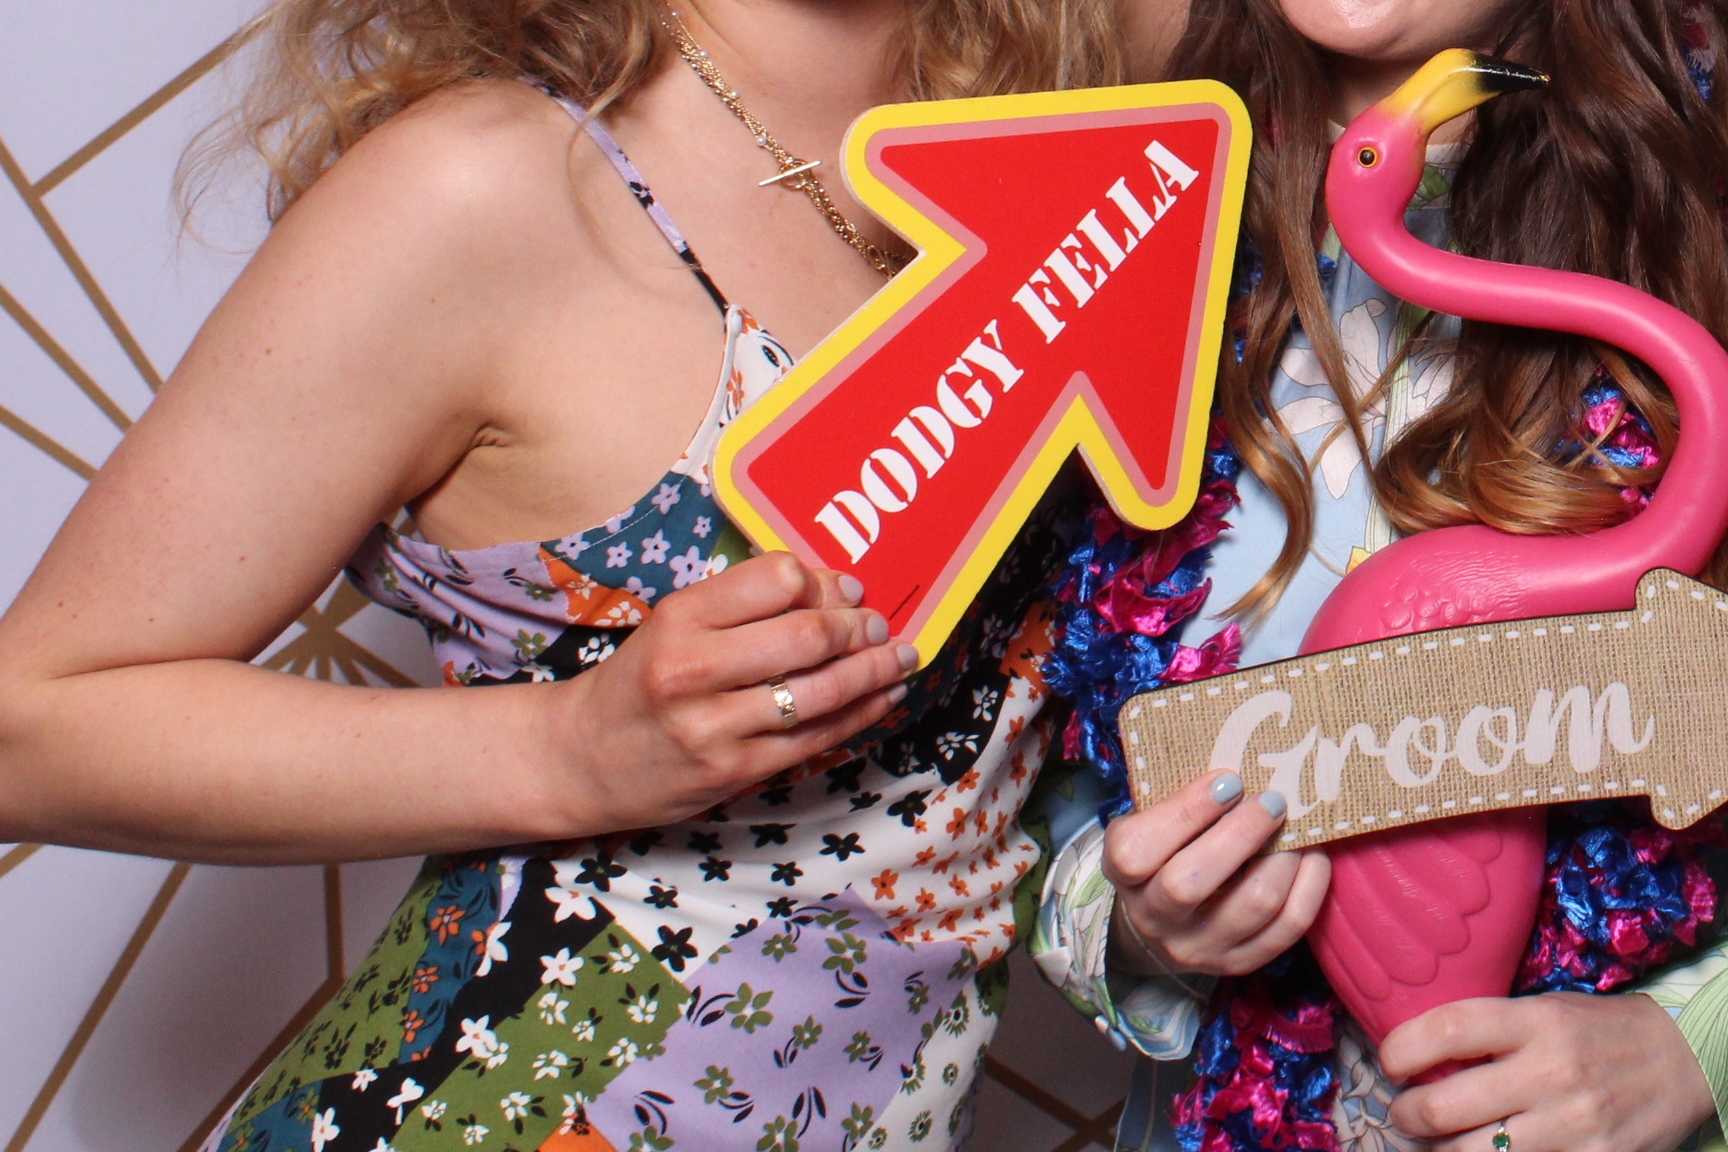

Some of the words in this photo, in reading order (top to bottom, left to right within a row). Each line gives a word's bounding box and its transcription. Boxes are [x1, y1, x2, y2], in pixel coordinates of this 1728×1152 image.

[814, 318, 1024, 565] DODGY
[1011, 139, 1199, 344] FELLA
[1209, 681, 1655, 819] Groom
